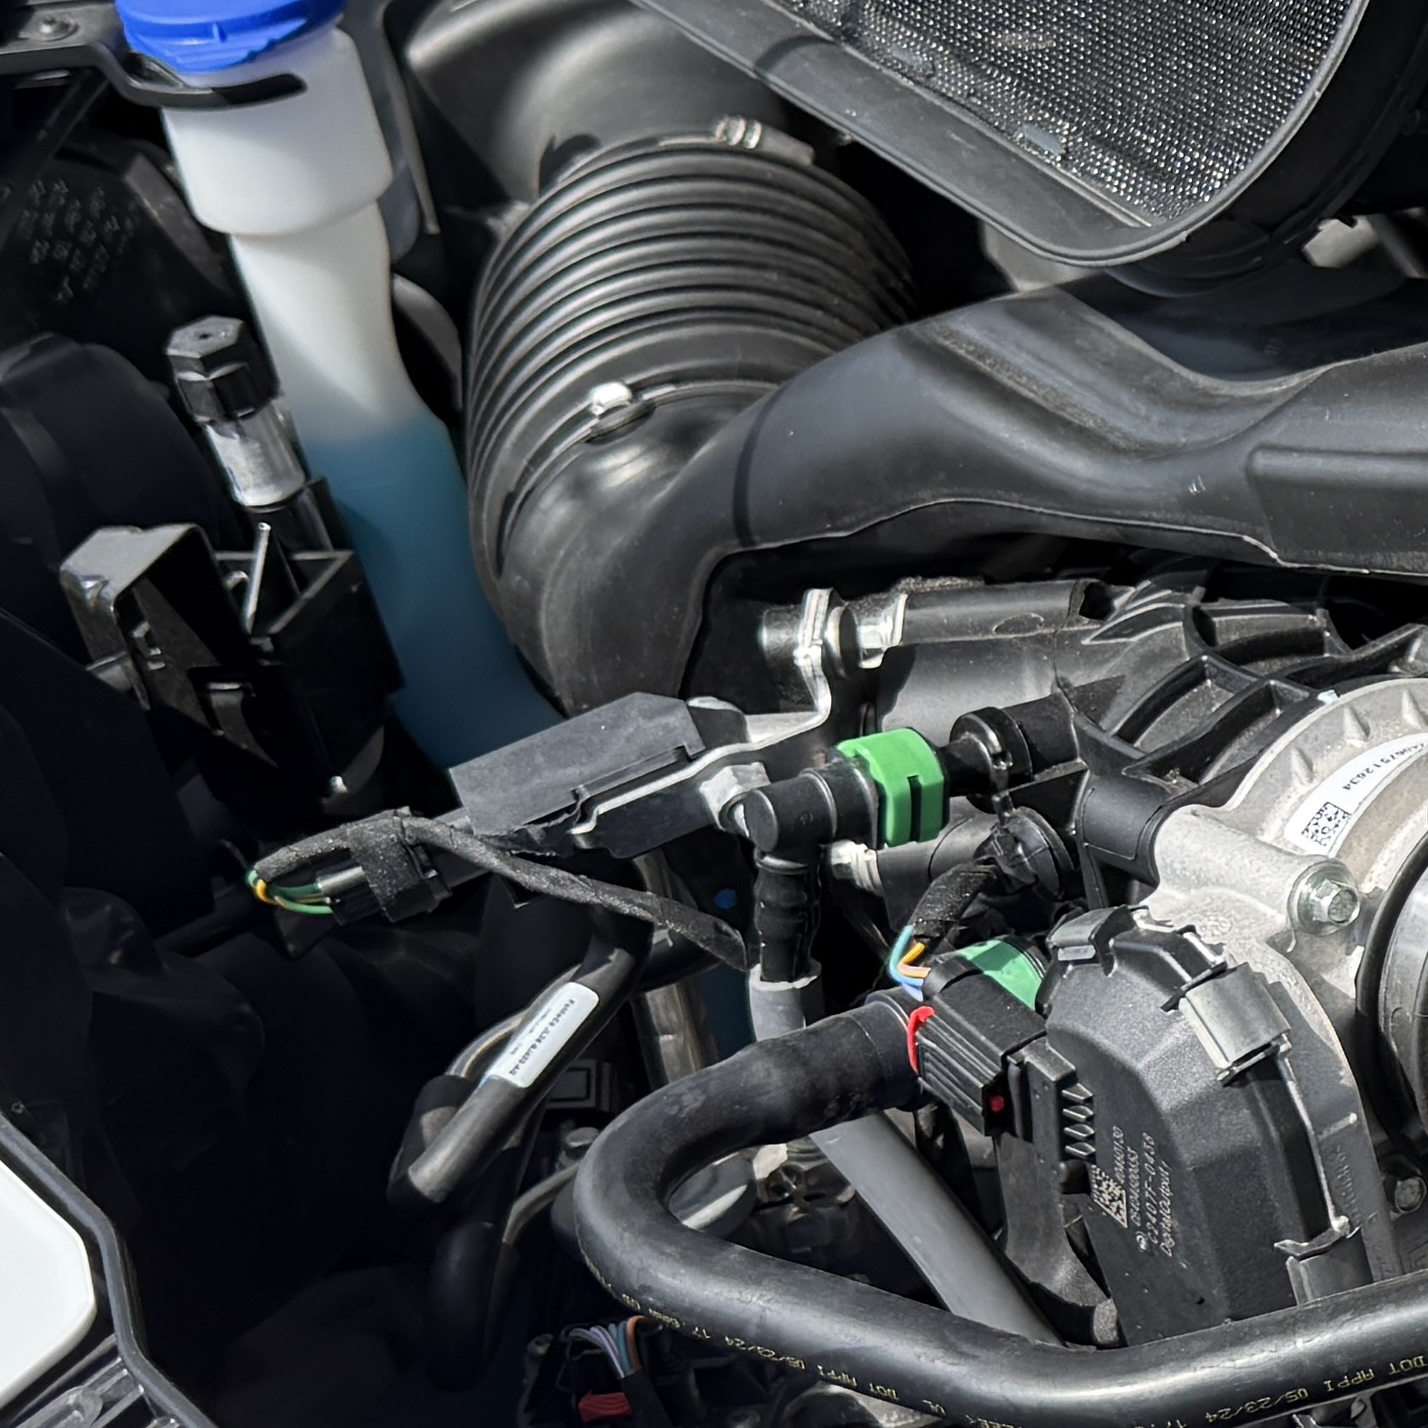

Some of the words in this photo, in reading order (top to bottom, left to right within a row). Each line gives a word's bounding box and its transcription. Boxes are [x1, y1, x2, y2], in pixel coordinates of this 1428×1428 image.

[1389, 1354, 1428, 1375] DOT
[1323, 1366, 1375, 1393] APPI
[1204, 1385, 1309, 1423] 05/23/24
